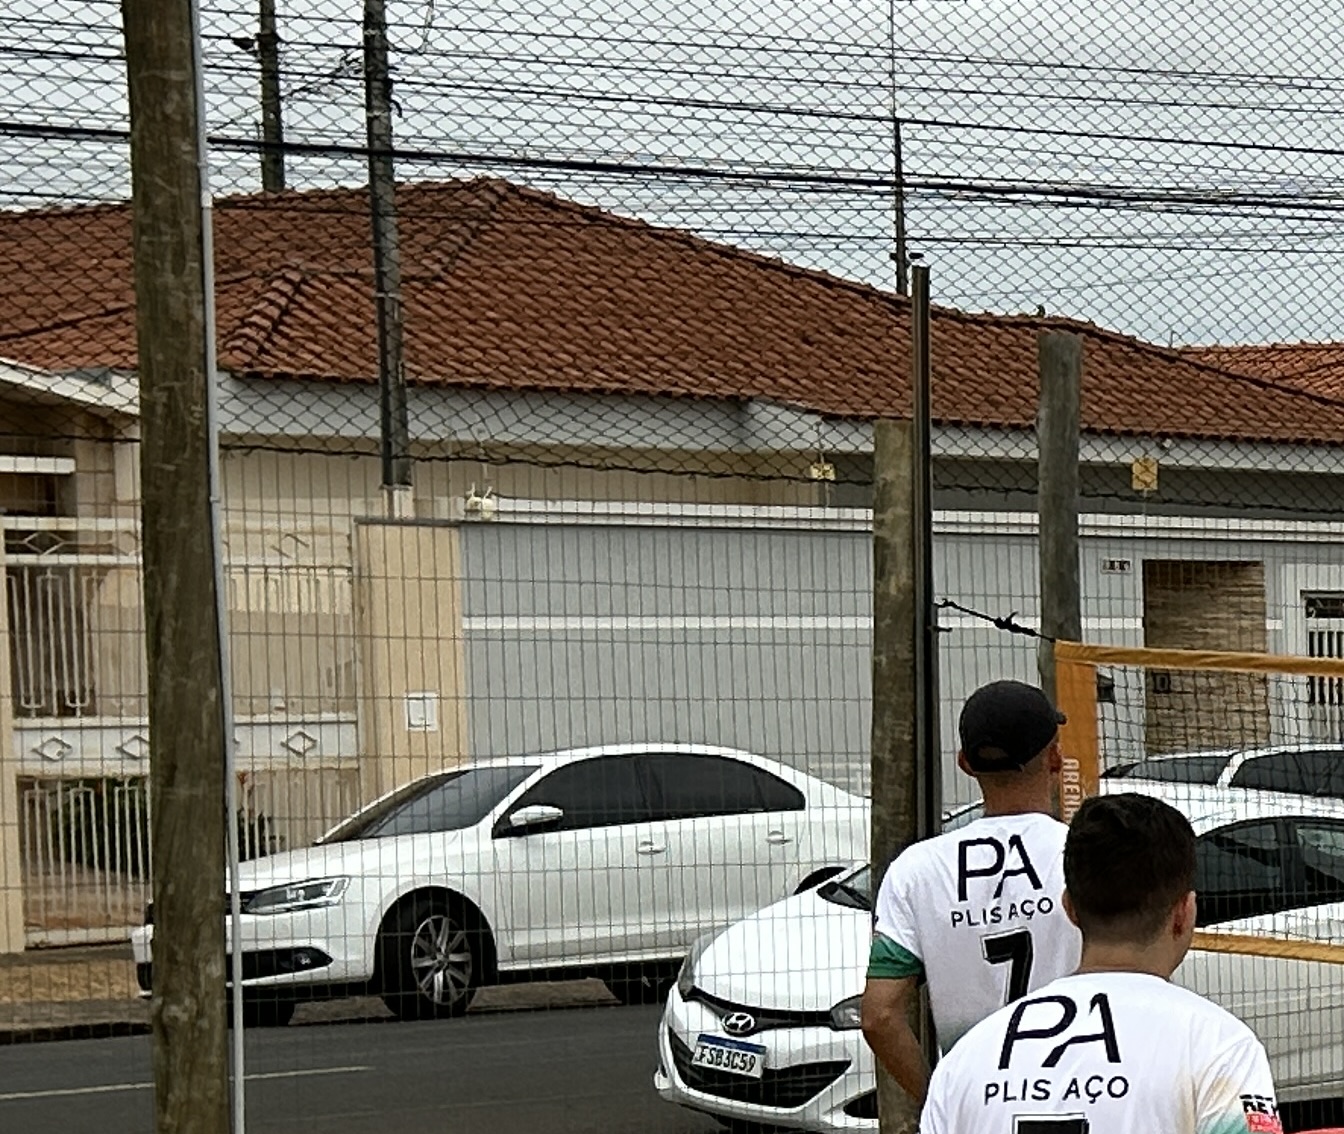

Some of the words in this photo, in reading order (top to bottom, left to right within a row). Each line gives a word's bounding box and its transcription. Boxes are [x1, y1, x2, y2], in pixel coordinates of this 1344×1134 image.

[958, 834, 1043, 902] PA
[980, 926, 1034, 1006] 7
[998, 993, 1121, 1070] PA
